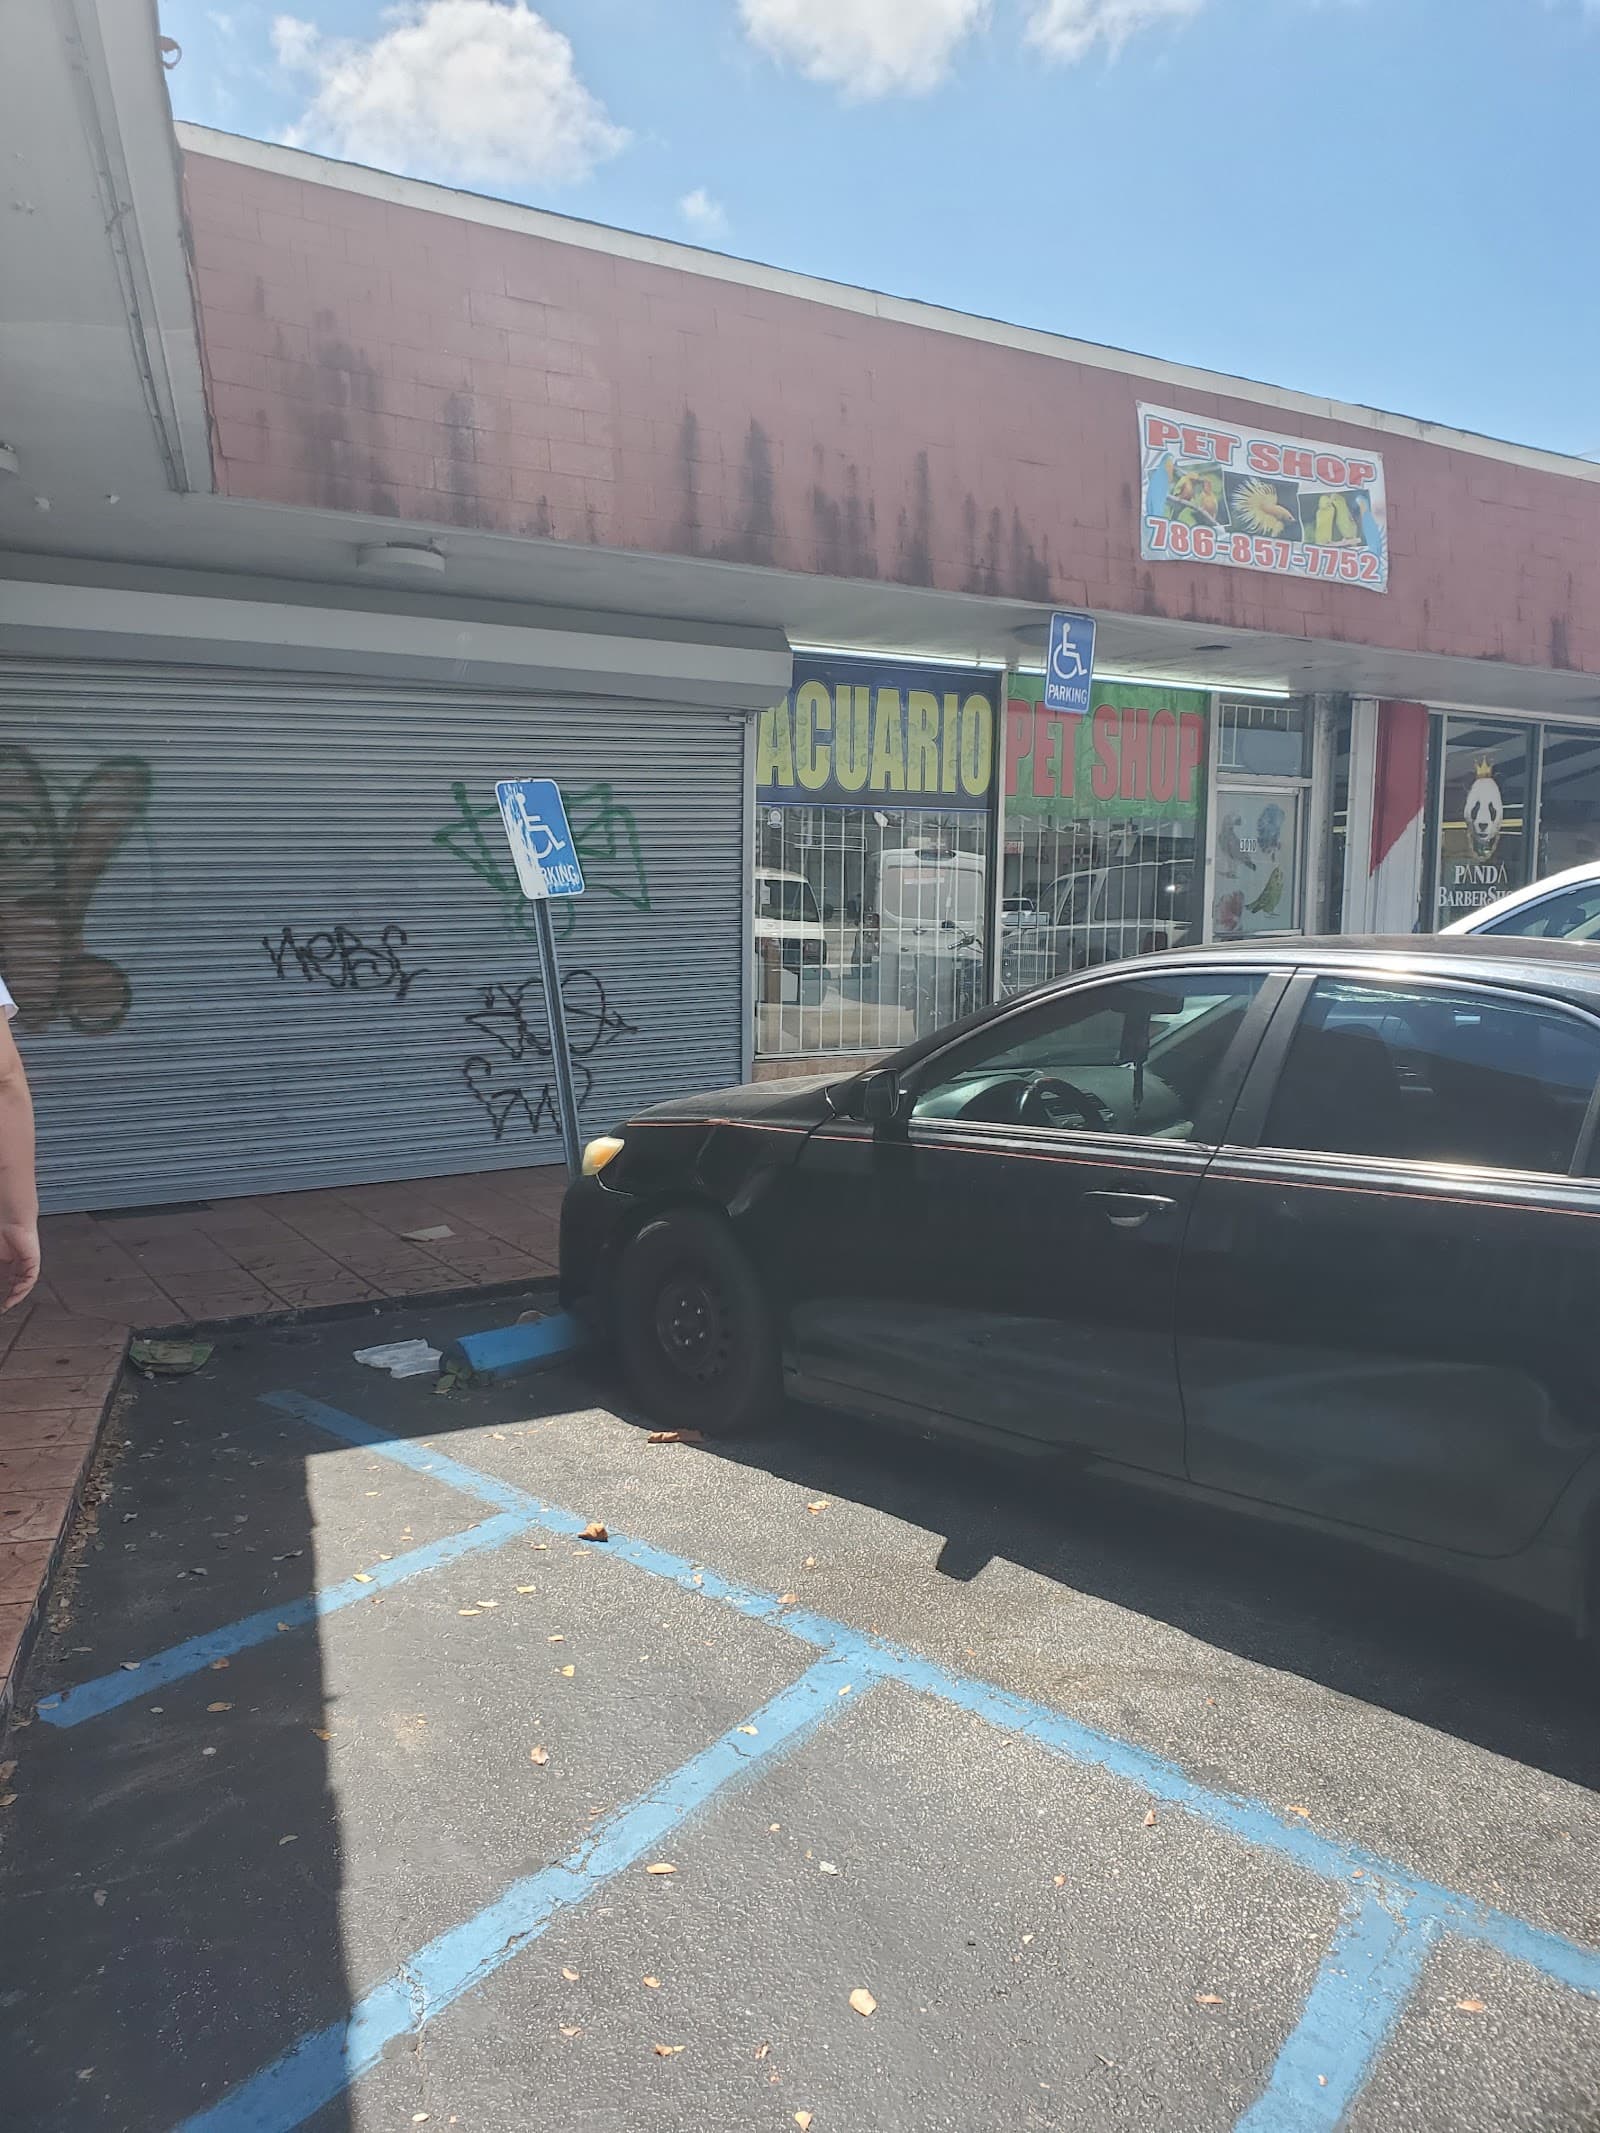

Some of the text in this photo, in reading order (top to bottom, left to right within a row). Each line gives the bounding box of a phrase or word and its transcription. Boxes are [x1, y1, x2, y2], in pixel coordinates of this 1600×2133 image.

[1145, 415, 1376, 487] PET SHOP
[1147, 517, 1382, 583] 786-857-7752
[1048, 684, 1088, 705] PARKING
[756, 680, 993, 796] ACUARIO
[1005, 699, 1205, 803] PET SHOP
[540, 864, 579, 887] RKING
[1454, 861, 1508, 884] PANDA
